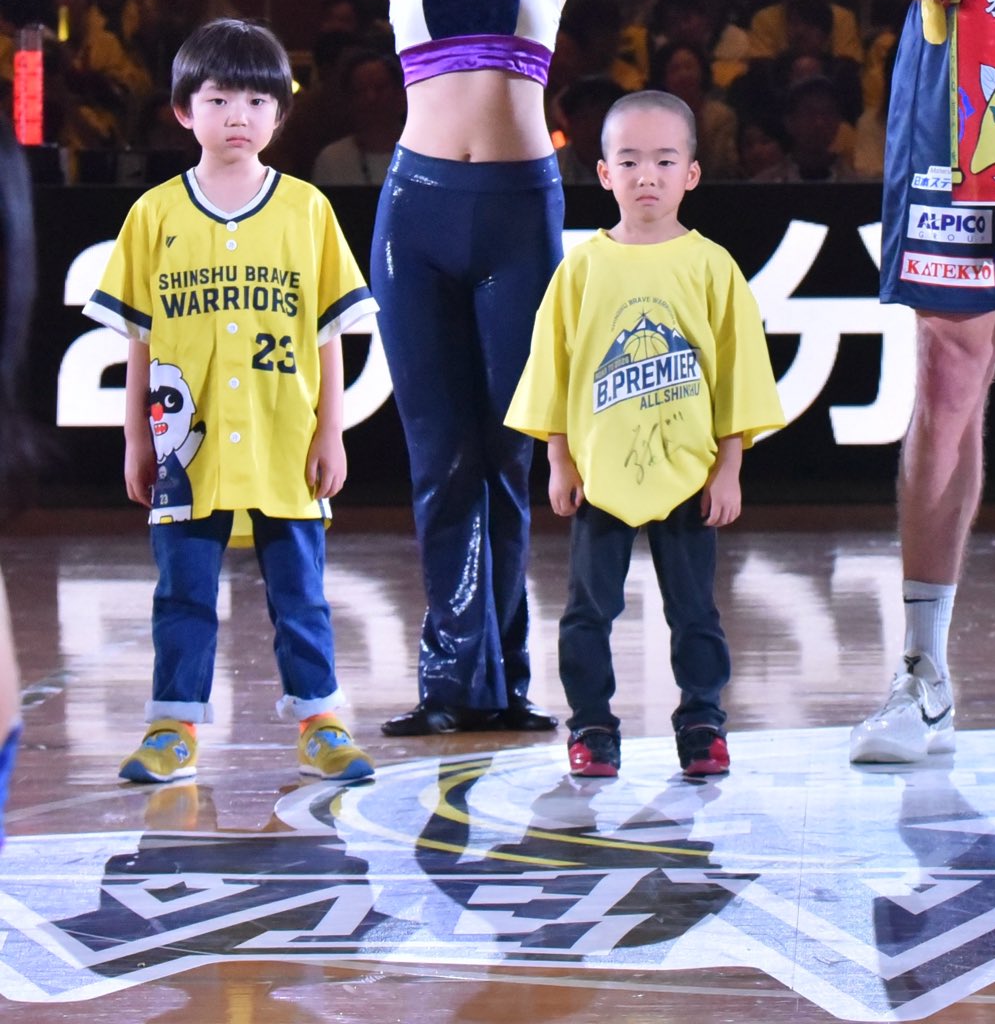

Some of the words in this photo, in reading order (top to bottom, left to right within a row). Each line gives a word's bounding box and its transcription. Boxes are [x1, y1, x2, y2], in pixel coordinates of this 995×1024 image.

[917, 211, 986, 234] ALPICO
[159, 265, 238, 290] SHINSHU
[245, 265, 301, 290] BRAVE
[906, 259, 992, 280] KATEKYO
[160, 286, 299, 319] WARRIORS
[251, 332, 297, 375] 23
[596, 352, 697, 409] B.PREMIER
